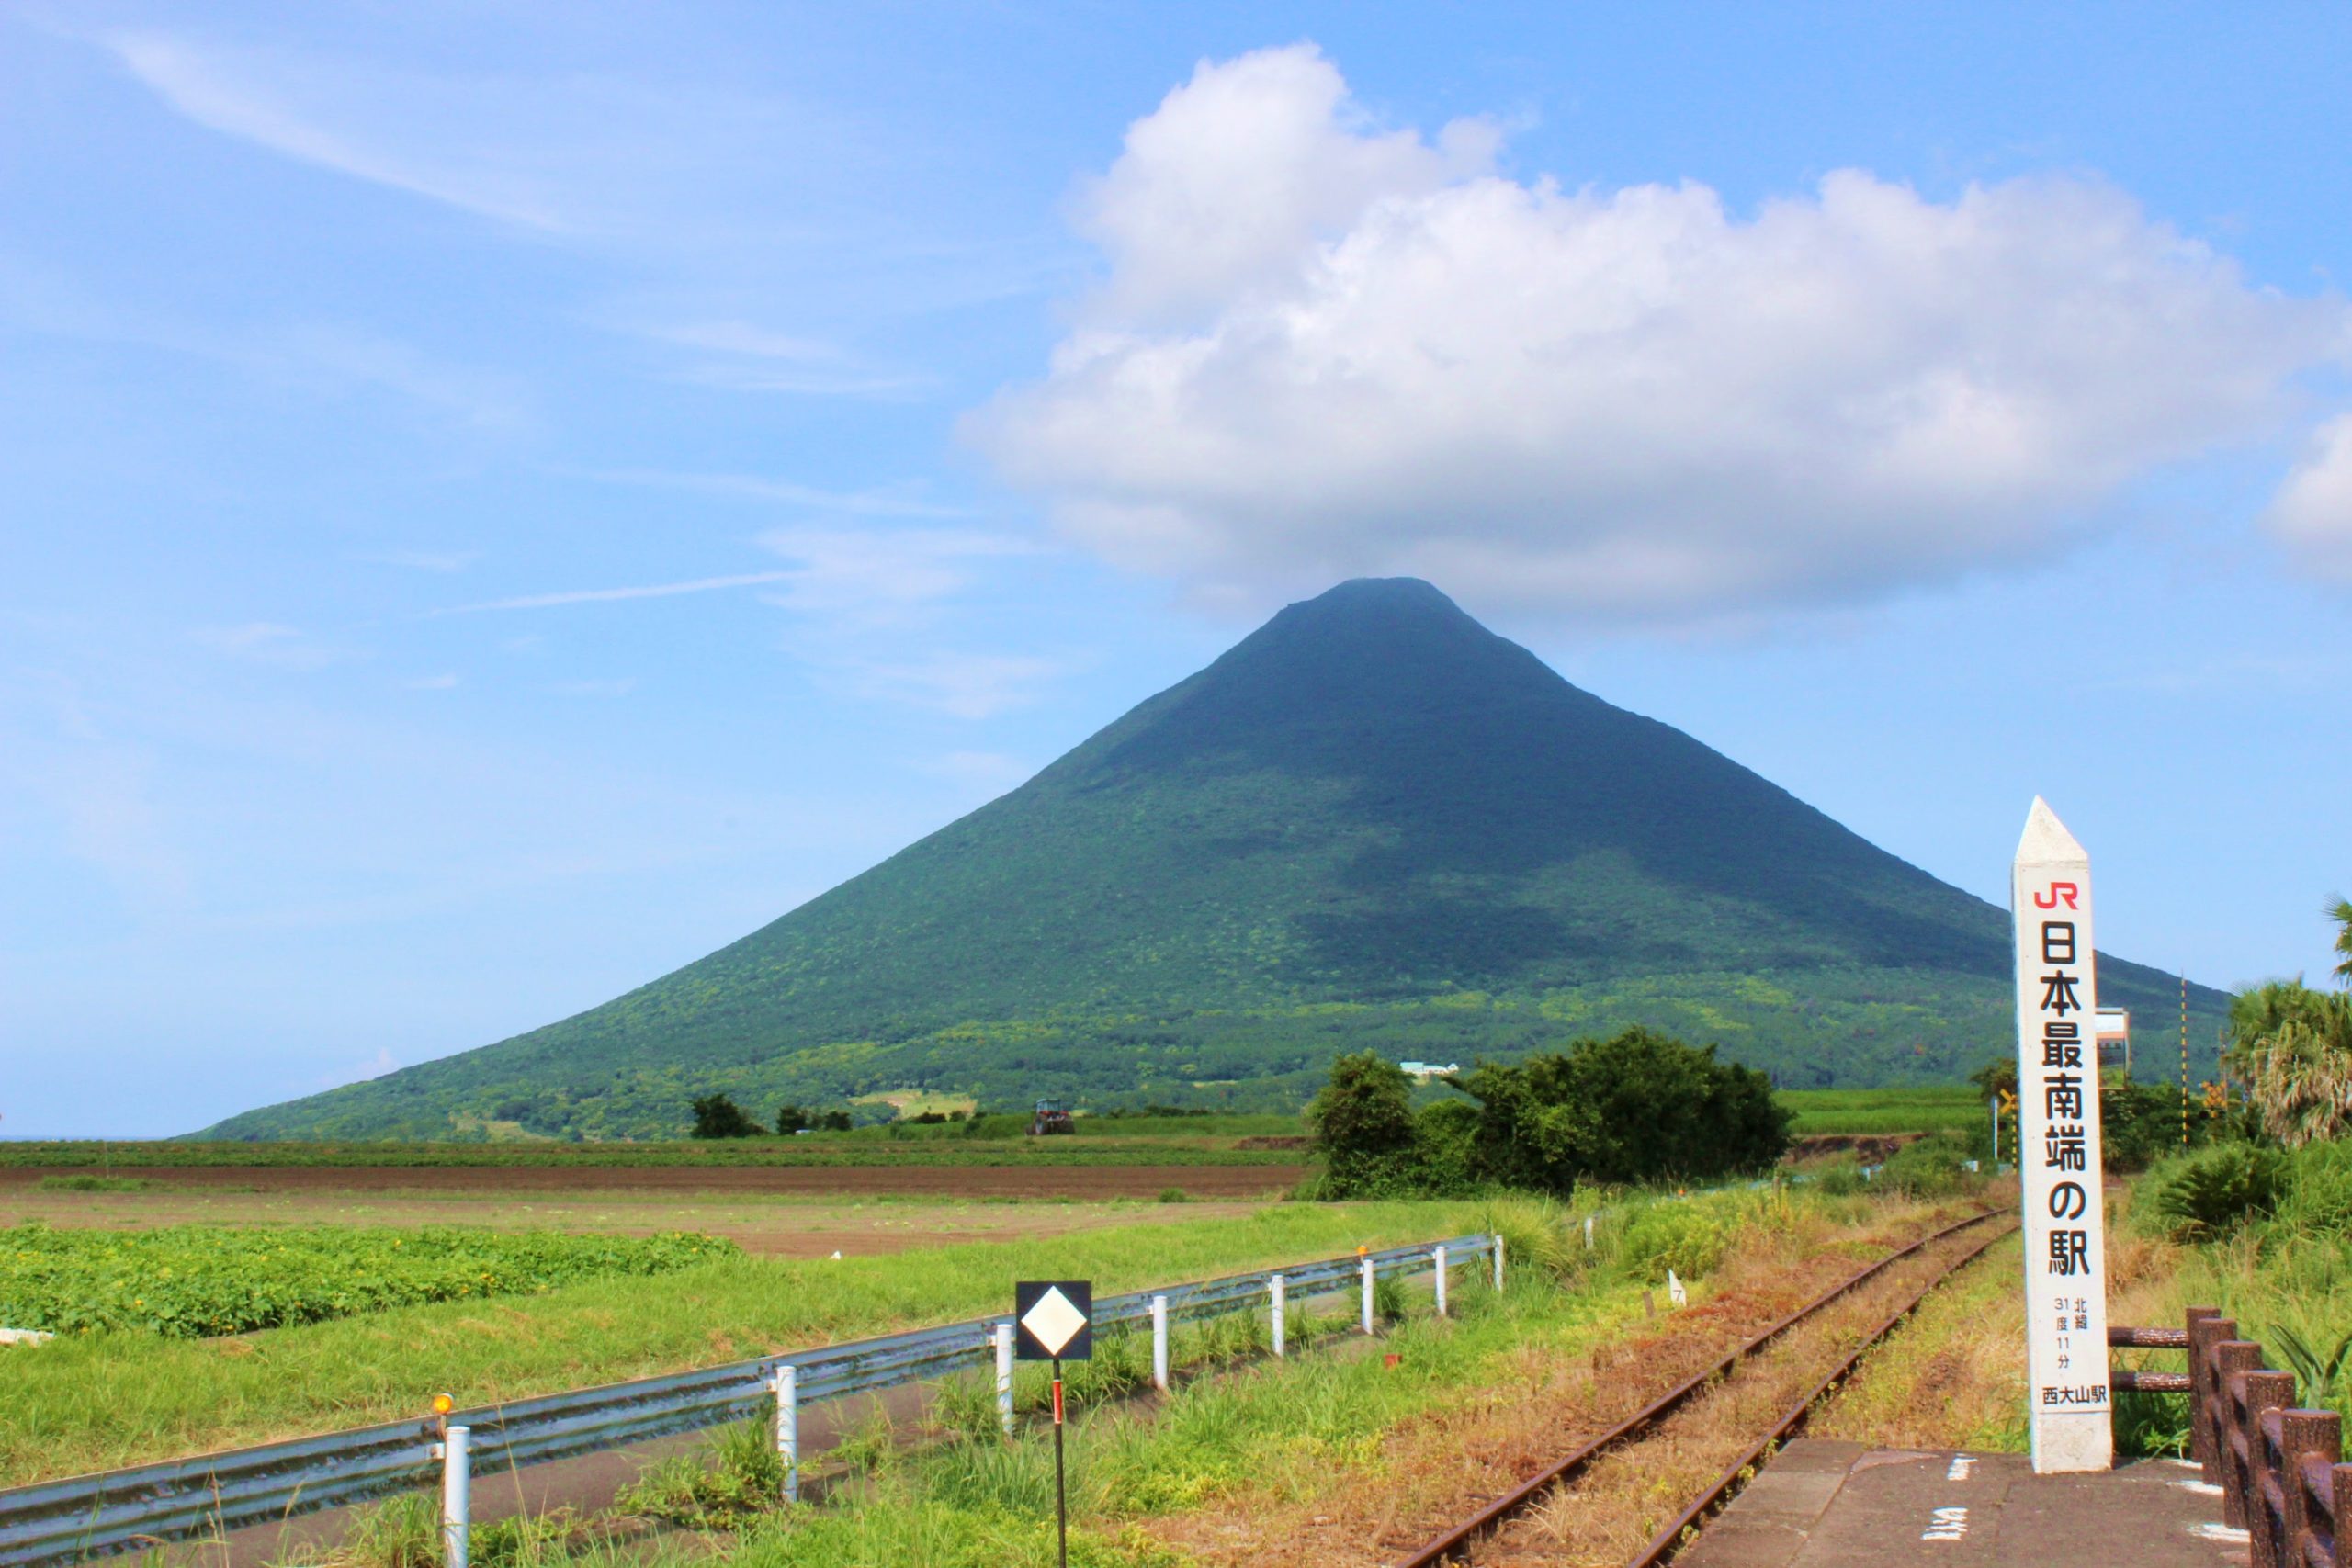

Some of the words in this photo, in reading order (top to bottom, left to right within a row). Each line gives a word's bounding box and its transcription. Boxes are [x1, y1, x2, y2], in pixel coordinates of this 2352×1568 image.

[2034, 882, 2078, 910] JR
[2040, 921, 2089, 1276] 日本最南端の駅
[1673, 1290, 1681, 1301] 7
[2075, 1298, 2087, 1330] 北緯
[2054, 1298, 2069, 1369] 31度11分
[2042, 1385, 2107, 1404] 西大山駅
